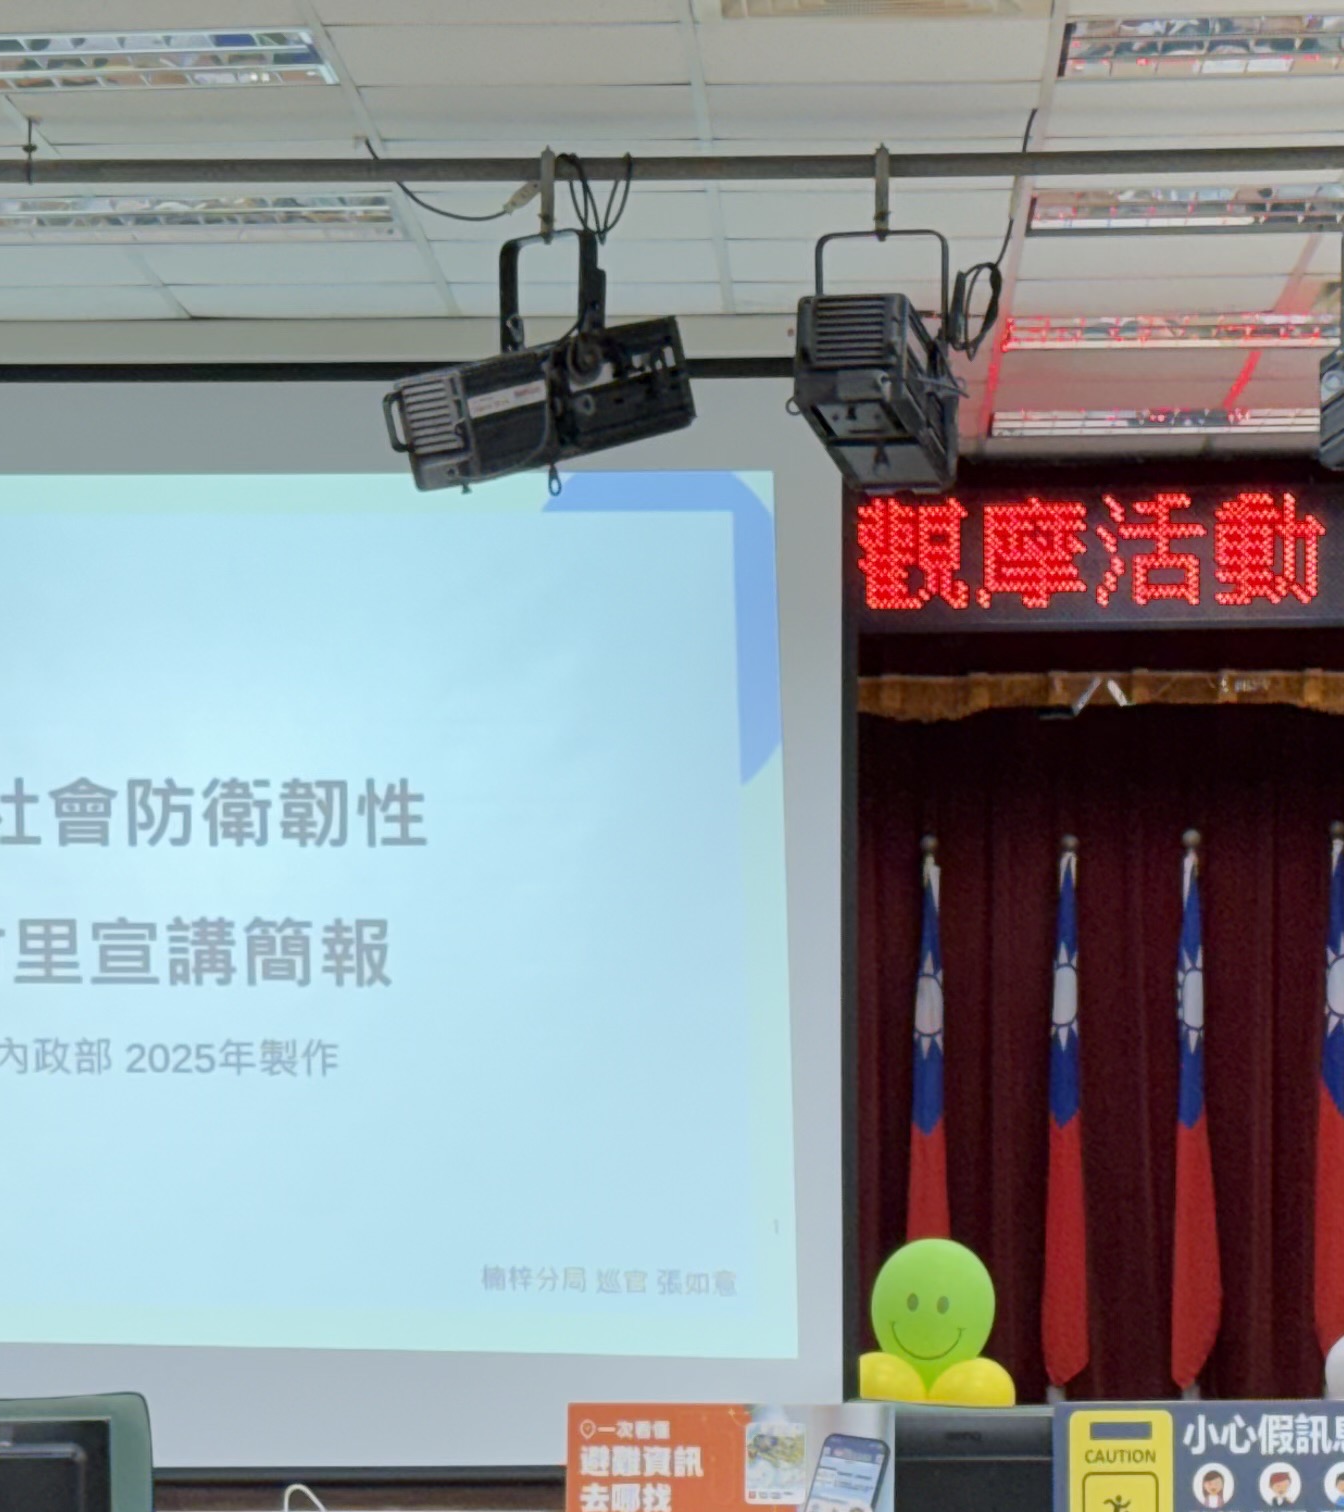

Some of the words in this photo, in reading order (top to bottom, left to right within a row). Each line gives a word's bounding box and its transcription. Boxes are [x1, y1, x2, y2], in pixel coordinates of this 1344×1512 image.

[857, 493, 1326, 609] 觀摩活動
[126, 1037, 340, 1079] 2025年製作
[481, 1264, 587, 1293] 楠梓分局
[596, 1268, 648, 1294] 巡官
[579, 1445, 704, 1478] 避難資訊
[1084, 1449, 1157, 1465] CAUTION
